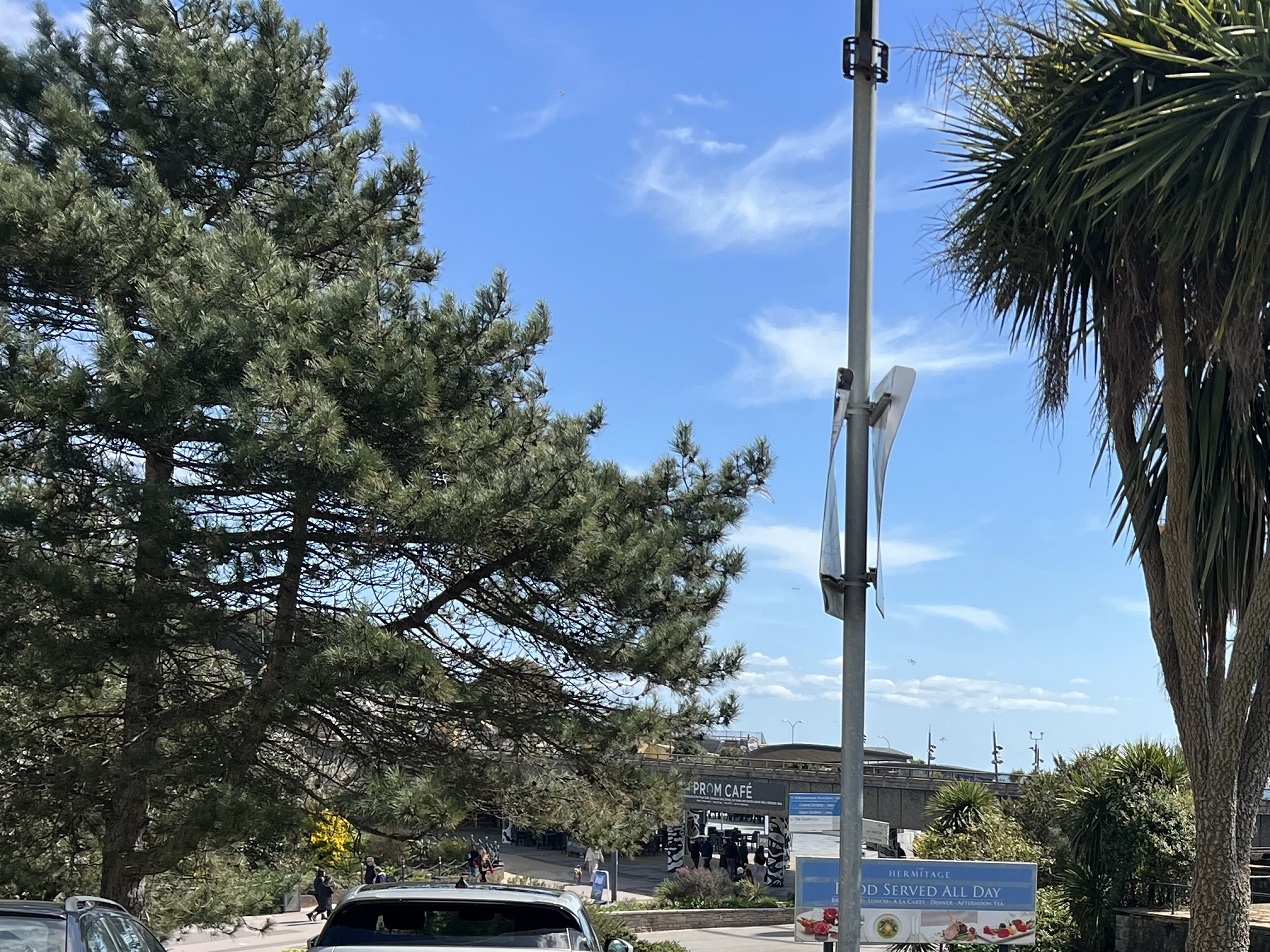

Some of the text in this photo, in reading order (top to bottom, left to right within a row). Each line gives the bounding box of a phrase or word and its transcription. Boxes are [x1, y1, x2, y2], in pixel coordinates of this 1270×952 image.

[693, 782, 753, 799] PROM CAFÉ
[889, 870, 951, 879] HERMITAGE
[835, 882, 878, 896] FOD
